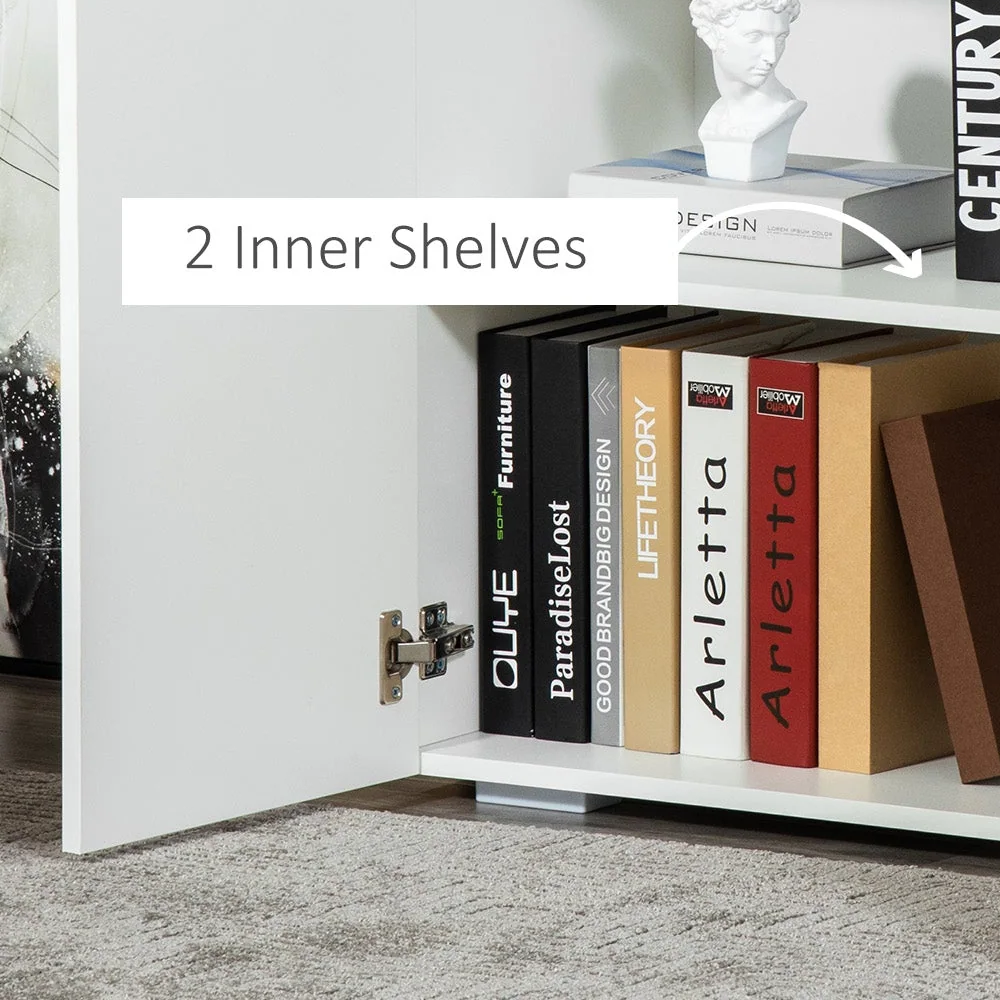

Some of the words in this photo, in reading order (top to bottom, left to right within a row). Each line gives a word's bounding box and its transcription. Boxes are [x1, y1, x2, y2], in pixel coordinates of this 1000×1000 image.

[497, 373, 514, 489] Furniture
[635, 396, 658, 579] LIFETHEORY
[693, 456, 727, 721] Arletta
[760, 464, 796, 729] Arletta
